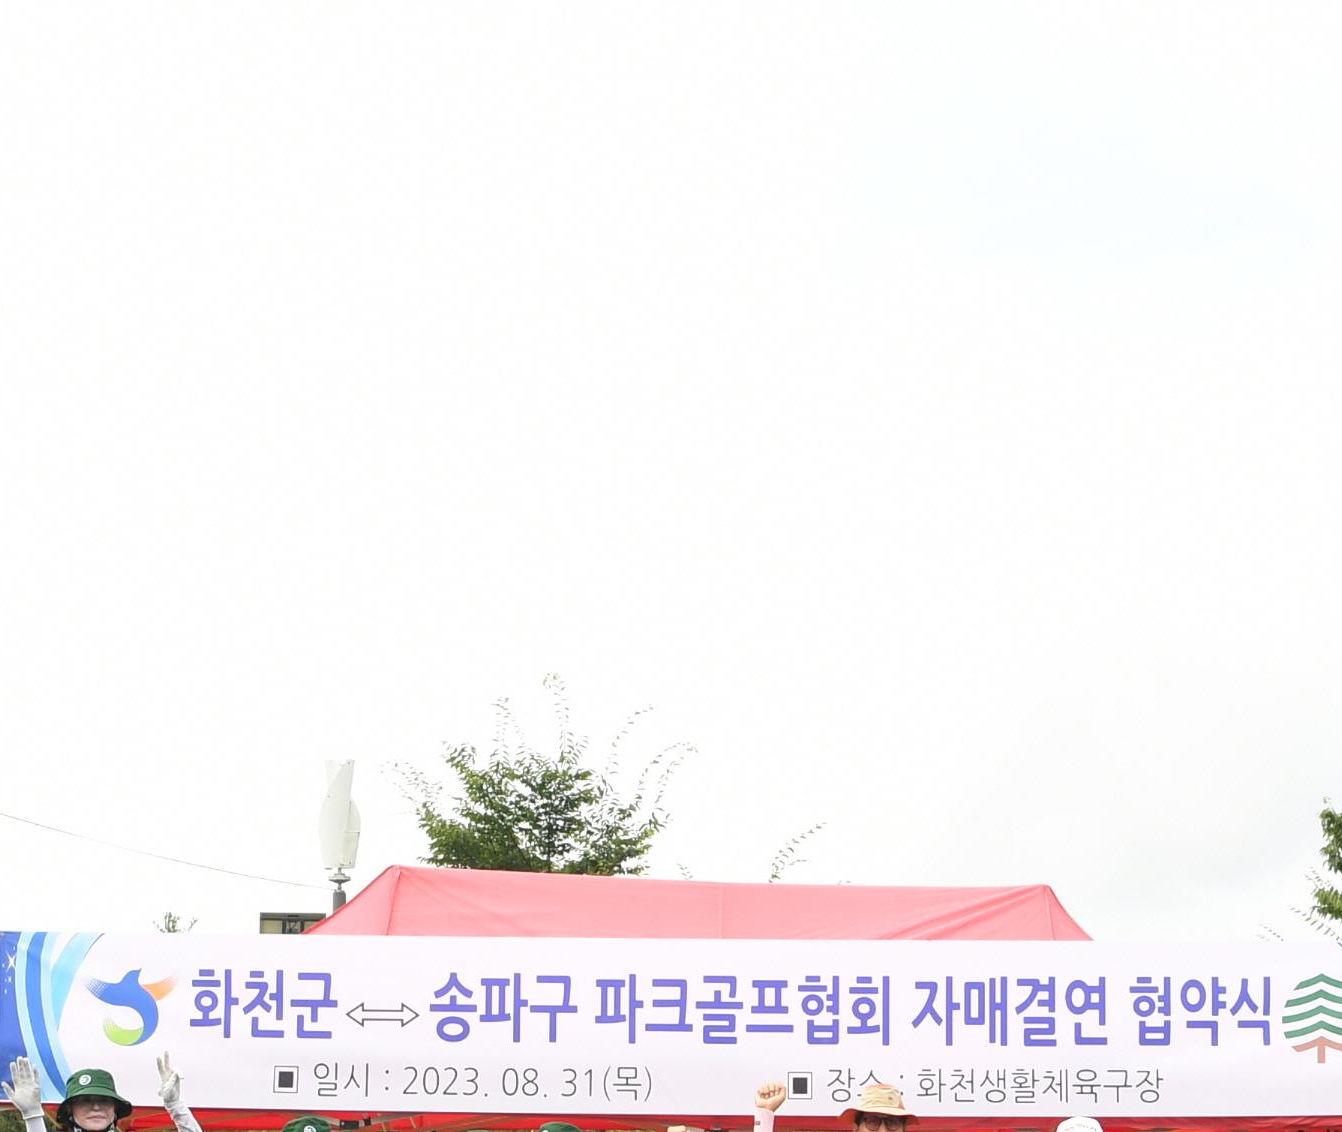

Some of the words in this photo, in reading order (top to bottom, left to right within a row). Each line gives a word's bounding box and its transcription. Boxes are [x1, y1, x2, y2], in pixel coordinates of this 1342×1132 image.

[190, 968, 339, 1040] 화천군
[430, 972, 579, 1043] 송파구
[595, 974, 891, 1046] 파크골프협회
[912, 975, 1108, 1048] 자매결연
[1129, 975, 1271, 1047] 협약식
[312, 1062, 370, 1098] 일시
[402, 1066, 489, 1097] 2023.
[501, 1067, 548, 1098] 08.
[561, 1066, 653, 1103] 31(목)
[916, 1068, 1164, 1105] 화천생활체육구장
